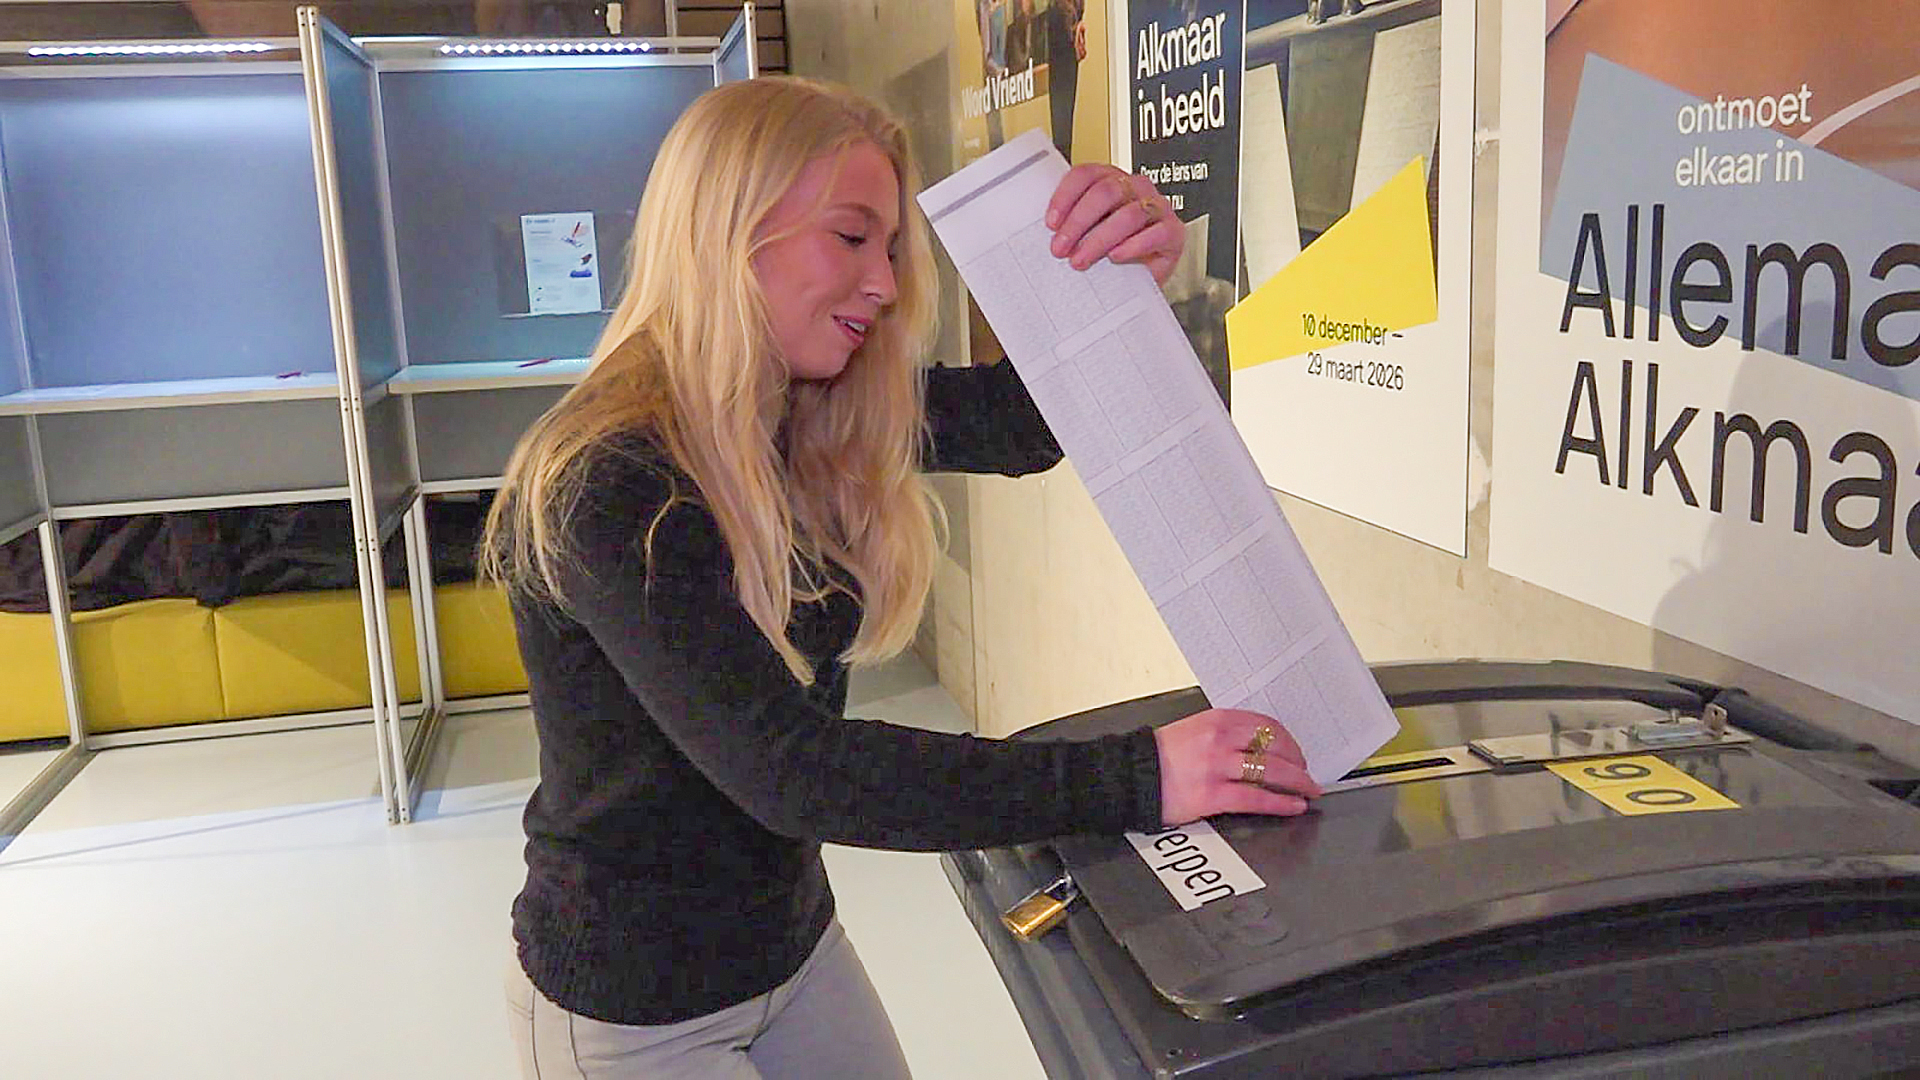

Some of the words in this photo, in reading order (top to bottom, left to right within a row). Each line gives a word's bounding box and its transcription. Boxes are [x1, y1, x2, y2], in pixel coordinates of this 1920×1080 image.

[1137, 12, 1225, 80] Alkmaar
[961, 76, 991, 119] Word
[991, 57, 1034, 111] Vriend
[1138, 88, 1157, 141] in
[1161, 69, 1225, 138] beeld
[1678, 83, 1812, 134] ontmoet
[1160, 163, 1171, 183] de
[1172, 161, 1190, 182] lens
[1191, 163, 1208, 180] van
[1675, 146, 1769, 186] elkaar
[1775, 139, 1804, 182] in
[1559, 203, 1920, 367] Allema
[1302, 313, 1316, 337] 10
[1318, 314, 1388, 346] december
[1307, 352, 1322, 376] 29
[1326, 360, 1363, 384] maart
[1367, 361, 1404, 391] 2026
[1555, 359, 1920, 562] Alkma
[1154, 827, 1235, 905] erpen
